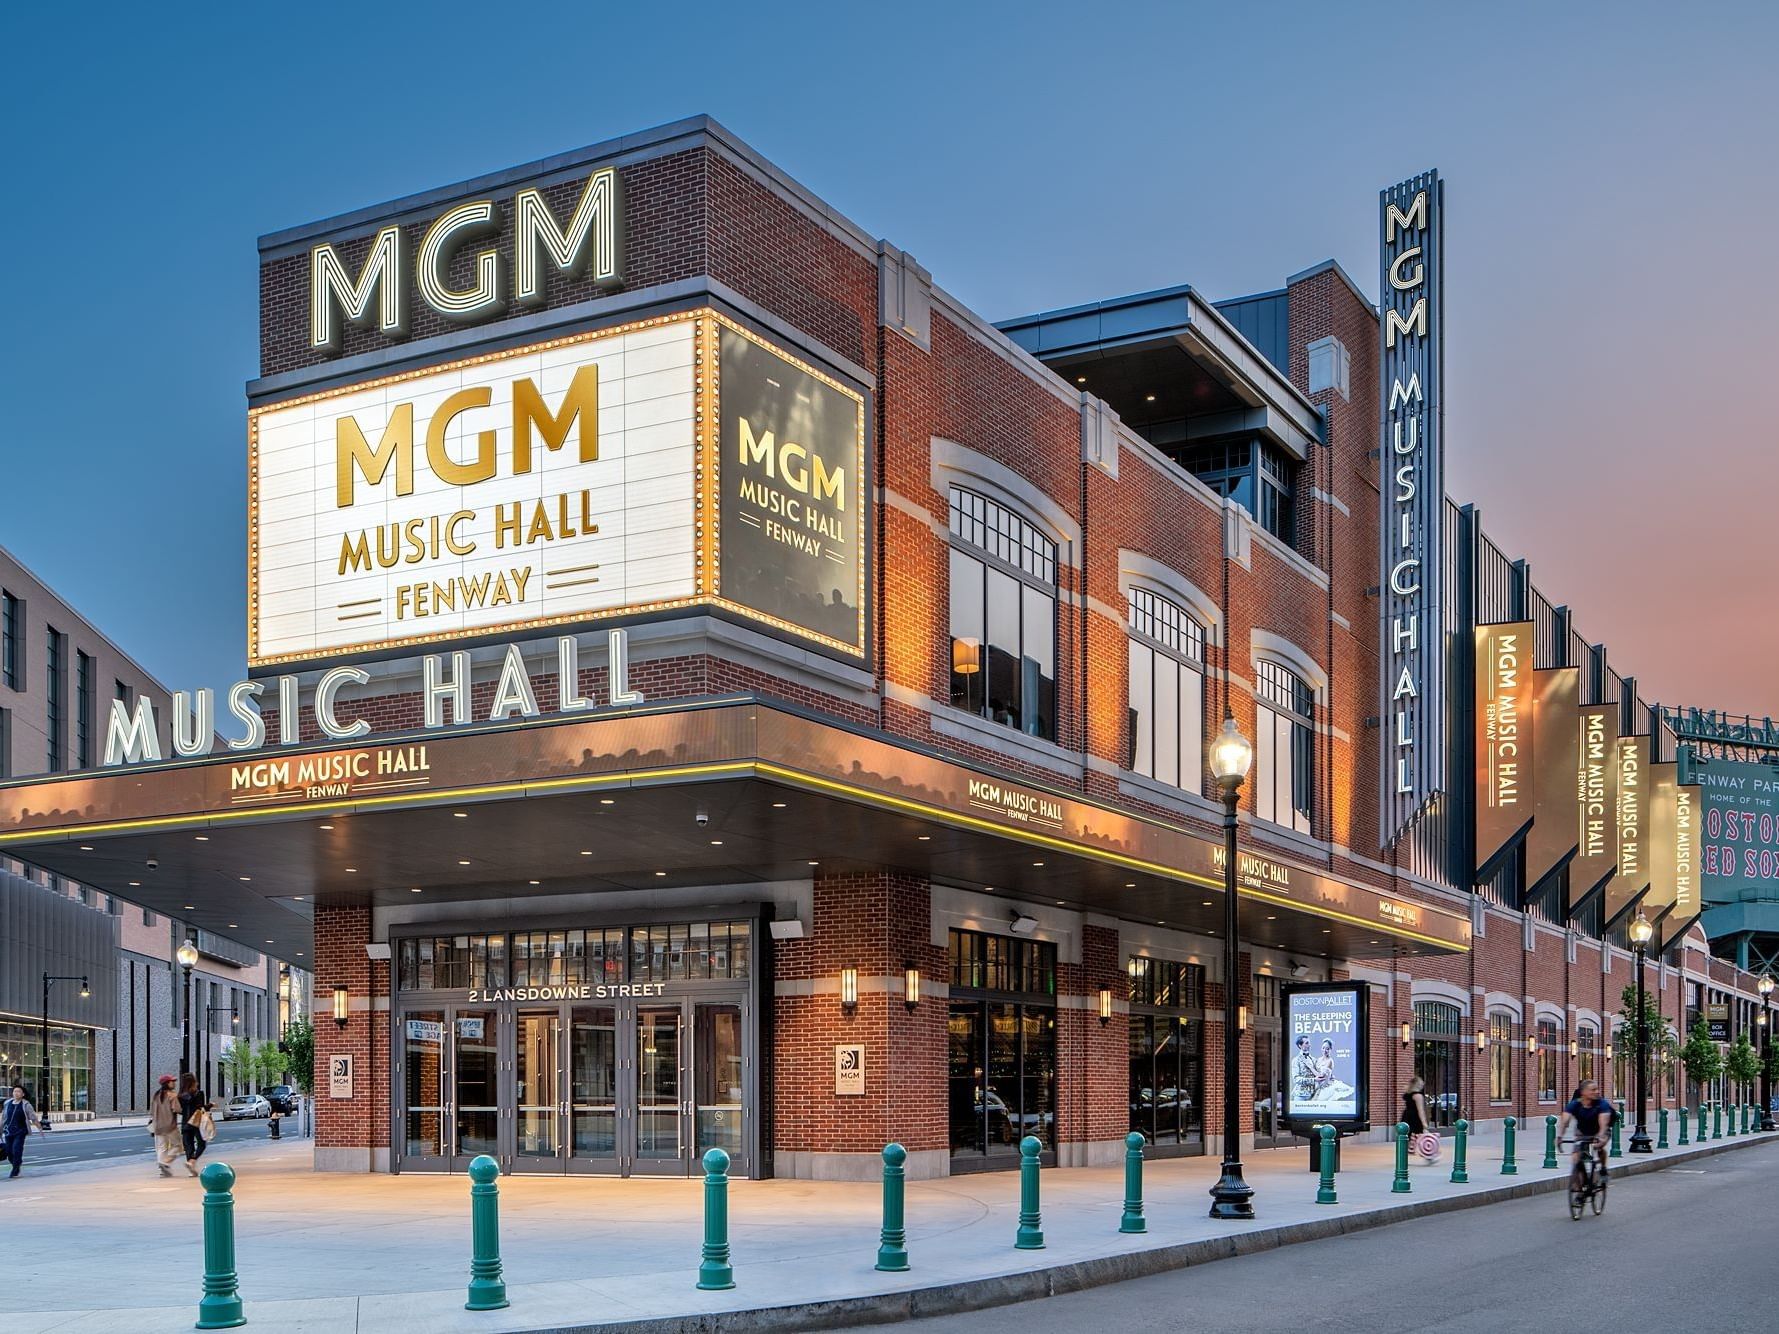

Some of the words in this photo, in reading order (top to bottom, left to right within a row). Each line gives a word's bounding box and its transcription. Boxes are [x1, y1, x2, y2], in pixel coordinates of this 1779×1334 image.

[312, 166, 622, 350] MGM
[1386, 191, 1425, 348] MGM
[336, 362, 599, 508] MGM
[739, 416, 845, 512] MGM
[1389, 372, 1423, 595] MUSIC
[739, 477, 800, 522] MUSIC
[806, 506, 845, 543] HALL
[338, 509, 477, 575] MUSIC
[495, 489, 599, 550] HALL
[766, 519, 821, 557] FENWAY
[396, 566, 531, 620] FENWAY
[1498, 634, 1517, 688] MGM
[103, 665, 370, 766] MUSIC
[423, 628, 644, 729] HALL
[1393, 615, 1418, 793] HALL
[1486, 703, 1496, 741] FENWAY
[1498, 695, 1517, 757] MUSIC
[1588, 714, 1604, 759] MGM
[231, 761, 290, 790] MGM
[297, 752, 370, 783] MUSIC
[377, 746, 430, 775] HALL
[1498, 763, 1517, 807] HALL
[1622, 744, 1638, 786] MGM
[1688, 772, 1746, 789] FENWAY
[306, 782, 349, 798] FENWAY
[969, 779, 1000, 803] MGM
[1003, 790, 1038, 814] MUSIC
[1040, 799, 1063, 820] HALL
[1577, 770, 1586, 802] FENWAY
[1588, 764, 1604, 815] MUSIC
[1709, 793, 1735, 803] HOME
[1739, 796, 1751, 805] OF
[1755, 798, 1772, 807] THE
[1007, 808, 1029, 822] FENWAY
[1622, 791, 1638, 838] MUSIC
[1677, 793, 1690, 828] MGM
[1700, 808, 1779, 845] OSTO
[1588, 819, 1604, 857] HALL
[1677, 832, 1690, 873] MUSIC
[1241, 856, 1269, 878] MUSIC
[1270, 864, 1289, 885] HALL
[1622, 842, 1638, 876] HALL
[1700, 845, 1737, 877] ED
[1676, 876, 1690, 906] HALL
[469, 990, 478, 1002] 2
[483, 986, 590, 1002] LANSDOWNE
[596, 983, 666, 998] STREET
[1294, 1013, 1311, 1021] THE
[1312, 1011, 1352, 1021] SLEEPING
[1295, 1020, 1352, 1034] BEAUTY
